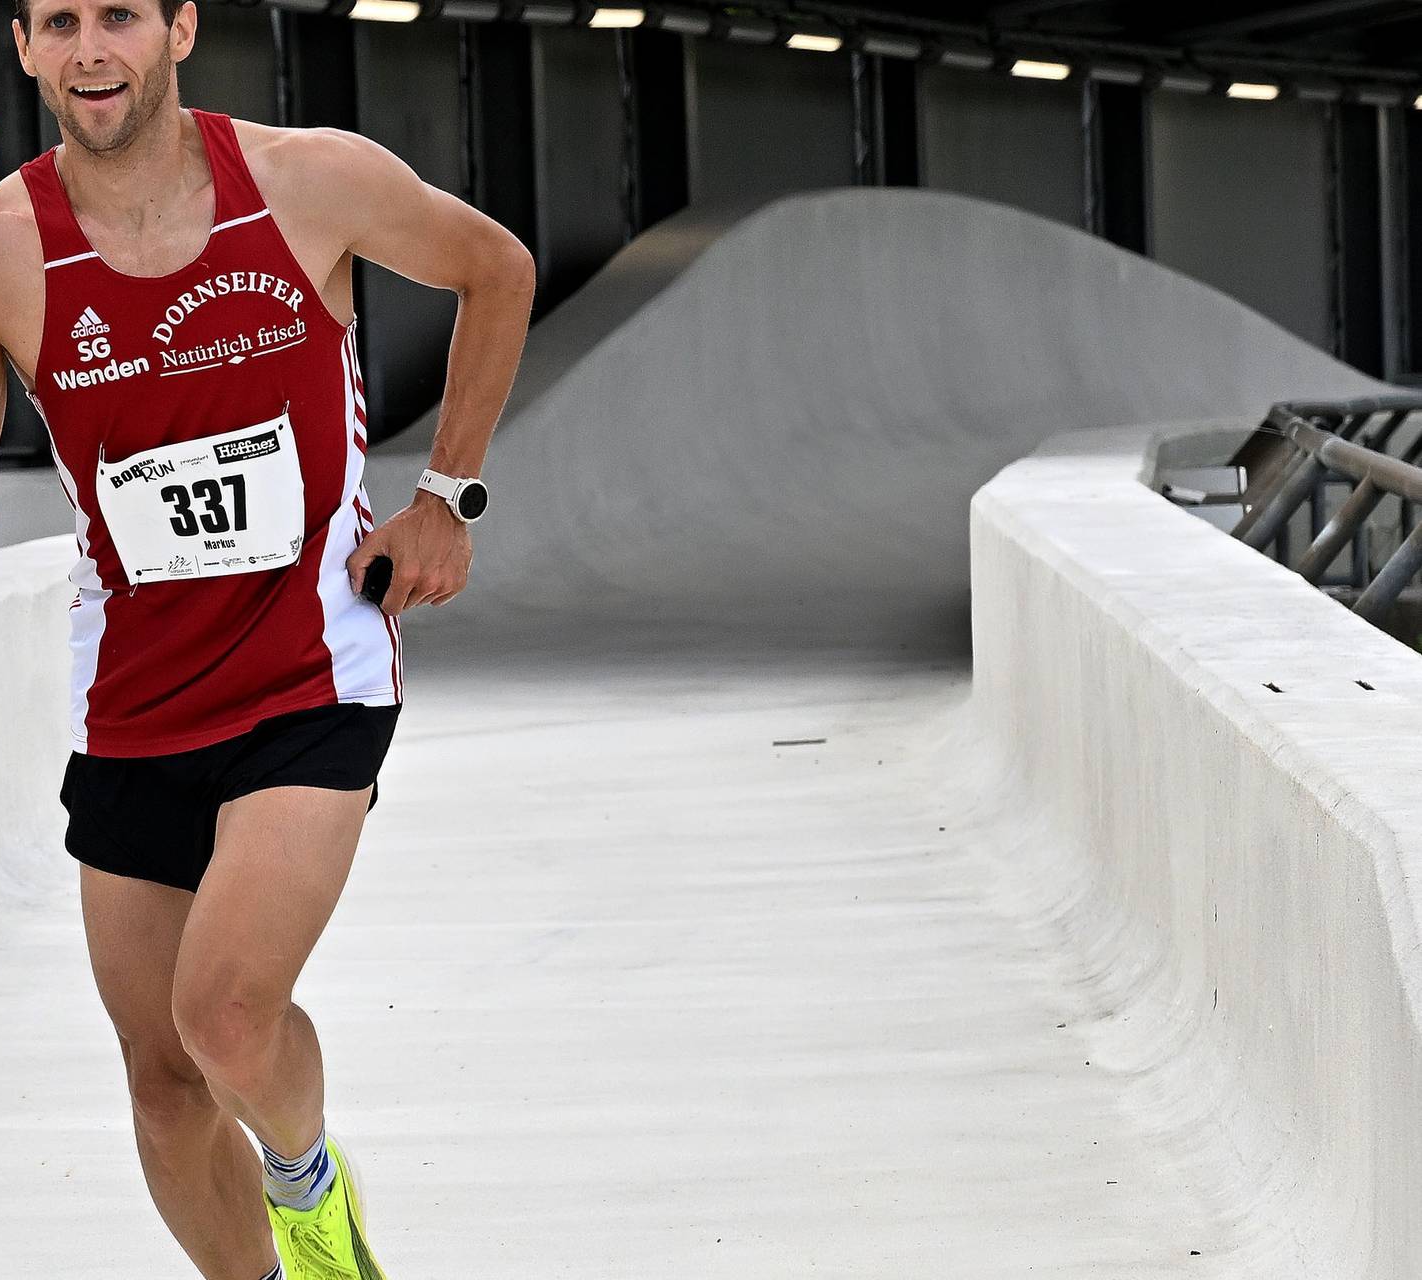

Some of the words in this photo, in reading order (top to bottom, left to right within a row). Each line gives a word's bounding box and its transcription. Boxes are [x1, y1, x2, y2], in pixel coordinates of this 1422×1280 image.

[152, 271, 304, 345] DORNSEIFER
[71, 322, 110, 339] adidas
[159, 333, 253, 369] Natürlich
[257, 317, 306, 347] frisch
[77, 337, 111, 362] SG
[52, 356, 150, 391] Wenden
[216, 437, 276, 459] Höffner
[109, 464, 142, 489] BOB
[139, 459, 176, 483] RUN
[160, 474, 248, 537] 337
[203, 538, 237, 551] Markus
